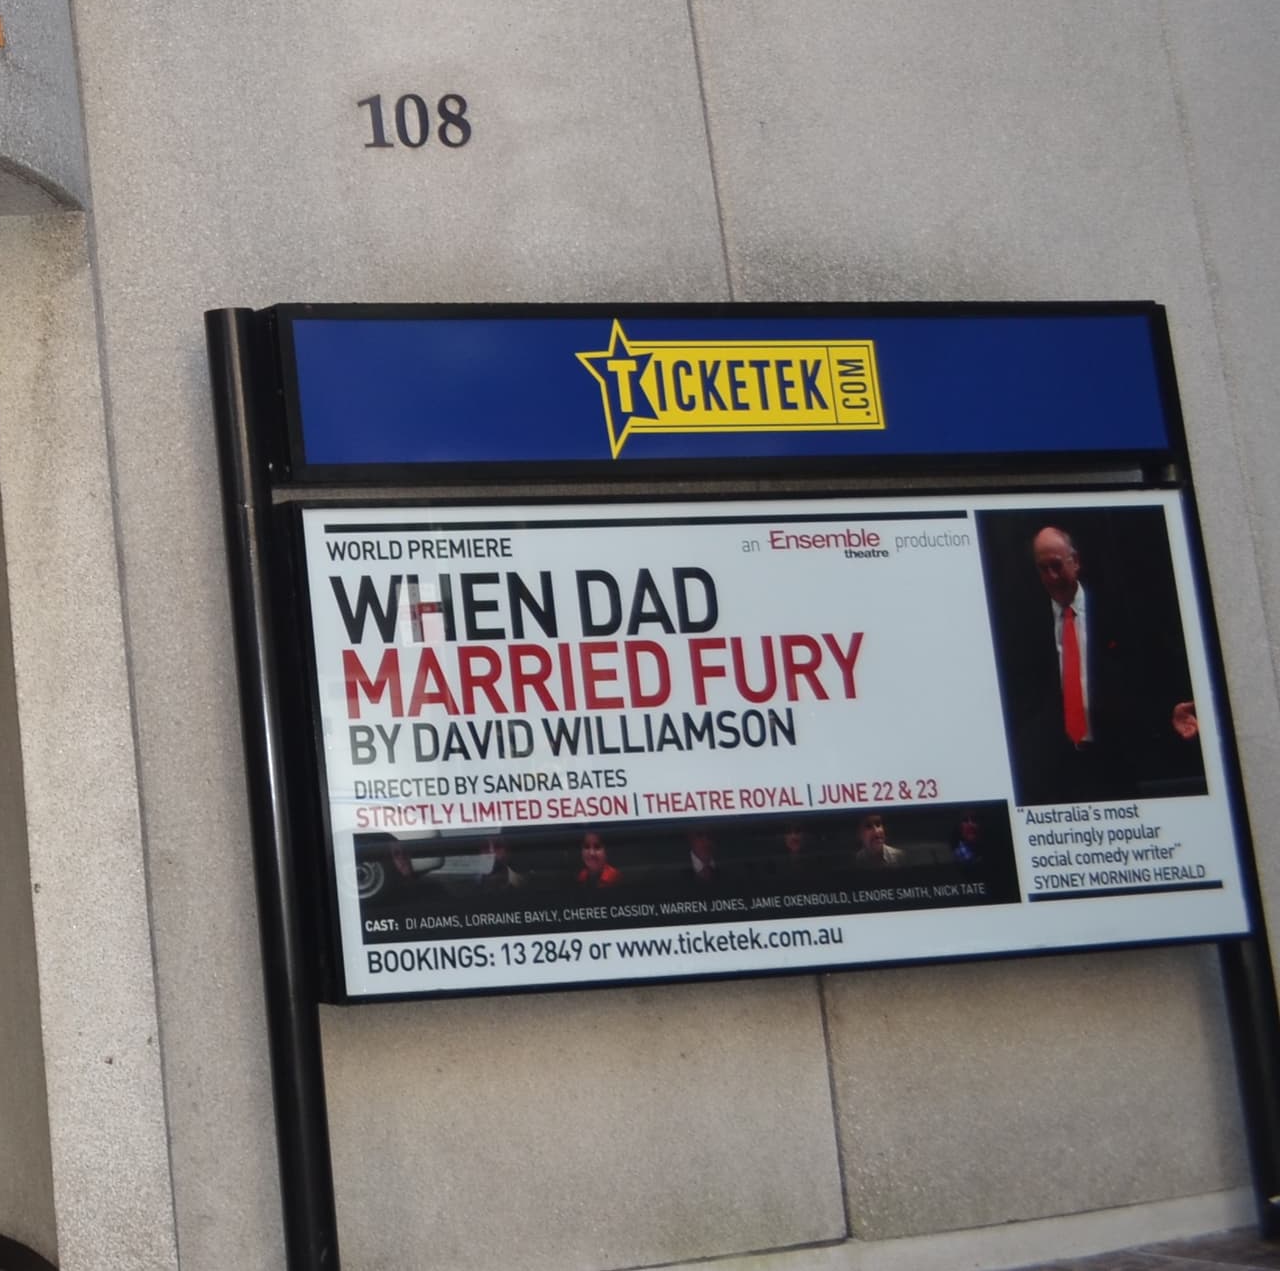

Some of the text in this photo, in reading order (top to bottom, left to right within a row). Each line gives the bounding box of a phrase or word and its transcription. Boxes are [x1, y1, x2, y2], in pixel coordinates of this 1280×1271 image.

[356, 93, 472, 148] 108
[605, 357, 830, 414] TICKETEK
[326, 537, 513, 562] WORLD PREMIERE
[741, 528, 971, 553] an Ensemble production
[844, 548, 890, 559] theatre
[328, 566, 720, 645] WHEN DAD
[341, 631, 865, 720] MARRIED FURY
[350, 707, 797, 765] BY DAVID WILLIAMSON
[354, 768, 628, 800] DIRECTED BY SANDRA BATES
[355, 778, 939, 828] STRICTLY LIMITED SEASON THEATRE ROYAL JUNE 22 & 23
[1104, 803, 1140, 820] most
[1027, 824, 1161, 847] enduringly popular
[1031, 851, 1072, 868] social
[1075, 848, 1130, 865] comedy
[1034, 864, 1207, 890] SYDNEY MORNING HERALD
[365, 918, 399, 932] CAST:
[405, 917, 418, 930] DI
[419, 914, 463, 929] ADAMS,
[464, 911, 522, 927] LORRAINE
[524, 909, 562, 924] BAYLY,
[562, 906, 608, 921] CHEREE
[610, 903, 659, 919] CASSIDY,
[660, 900, 708, 915] WARREN
[710, 898, 748, 912] JONES,
[750, 895, 782, 910] JAMIE
[853, 888, 895, 904] LENORE
[897, 886, 931, 900] SMITH,
[933, 884, 960, 898] NICK
[961, 882, 986, 896] TATE
[366, 926, 844, 974] BOOKINGS: 13 2849 or www.ticketek.com.au
